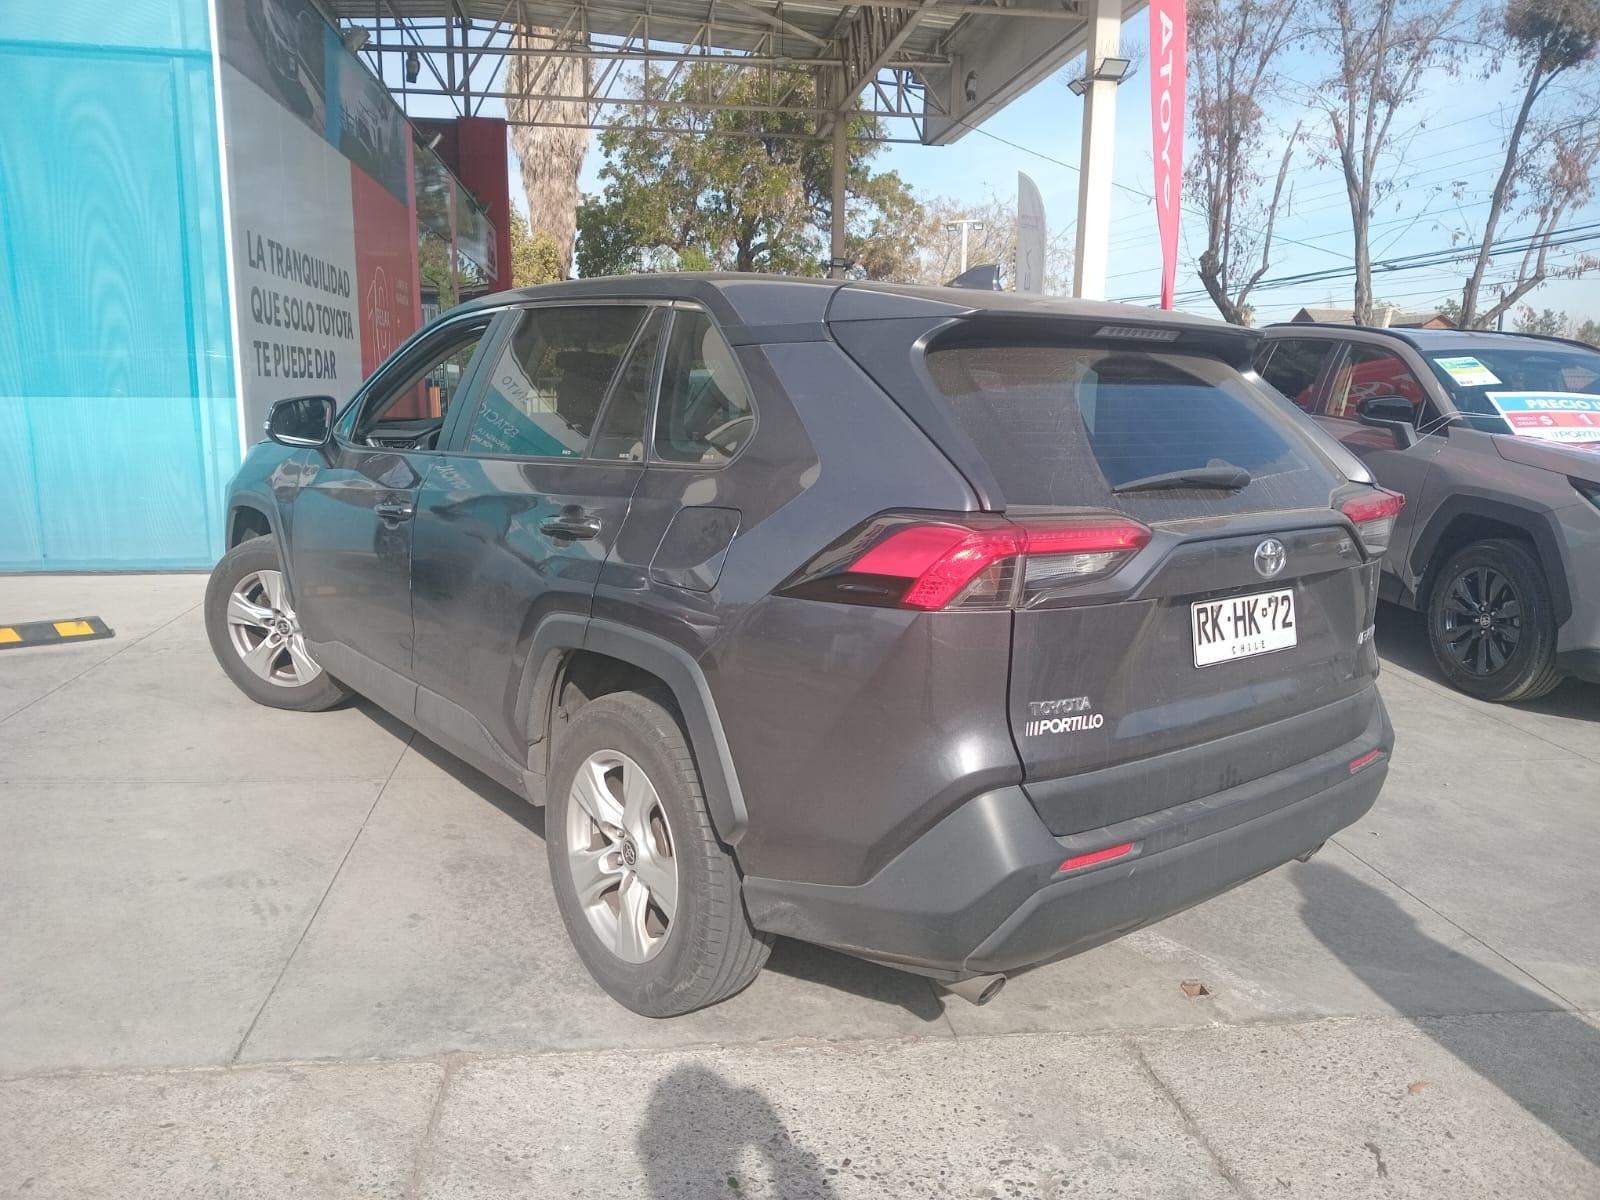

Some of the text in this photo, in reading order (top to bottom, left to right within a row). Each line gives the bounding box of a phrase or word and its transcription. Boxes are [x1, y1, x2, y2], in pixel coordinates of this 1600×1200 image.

[247, 230, 267, 272] LA
[268, 239, 350, 298] TRANQUILIDAD
[251, 286, 354, 340] QUE SOLO TOYOTA
[254, 340, 337, 379] TE PUEDE DAR
[1525, 399, 1589, 410] PRECIO
[1231, 640, 1267, 656] CHILE
[1029, 697, 1091, 716] TOYOTA
[1038, 713, 1104, 736] PORTILLO
